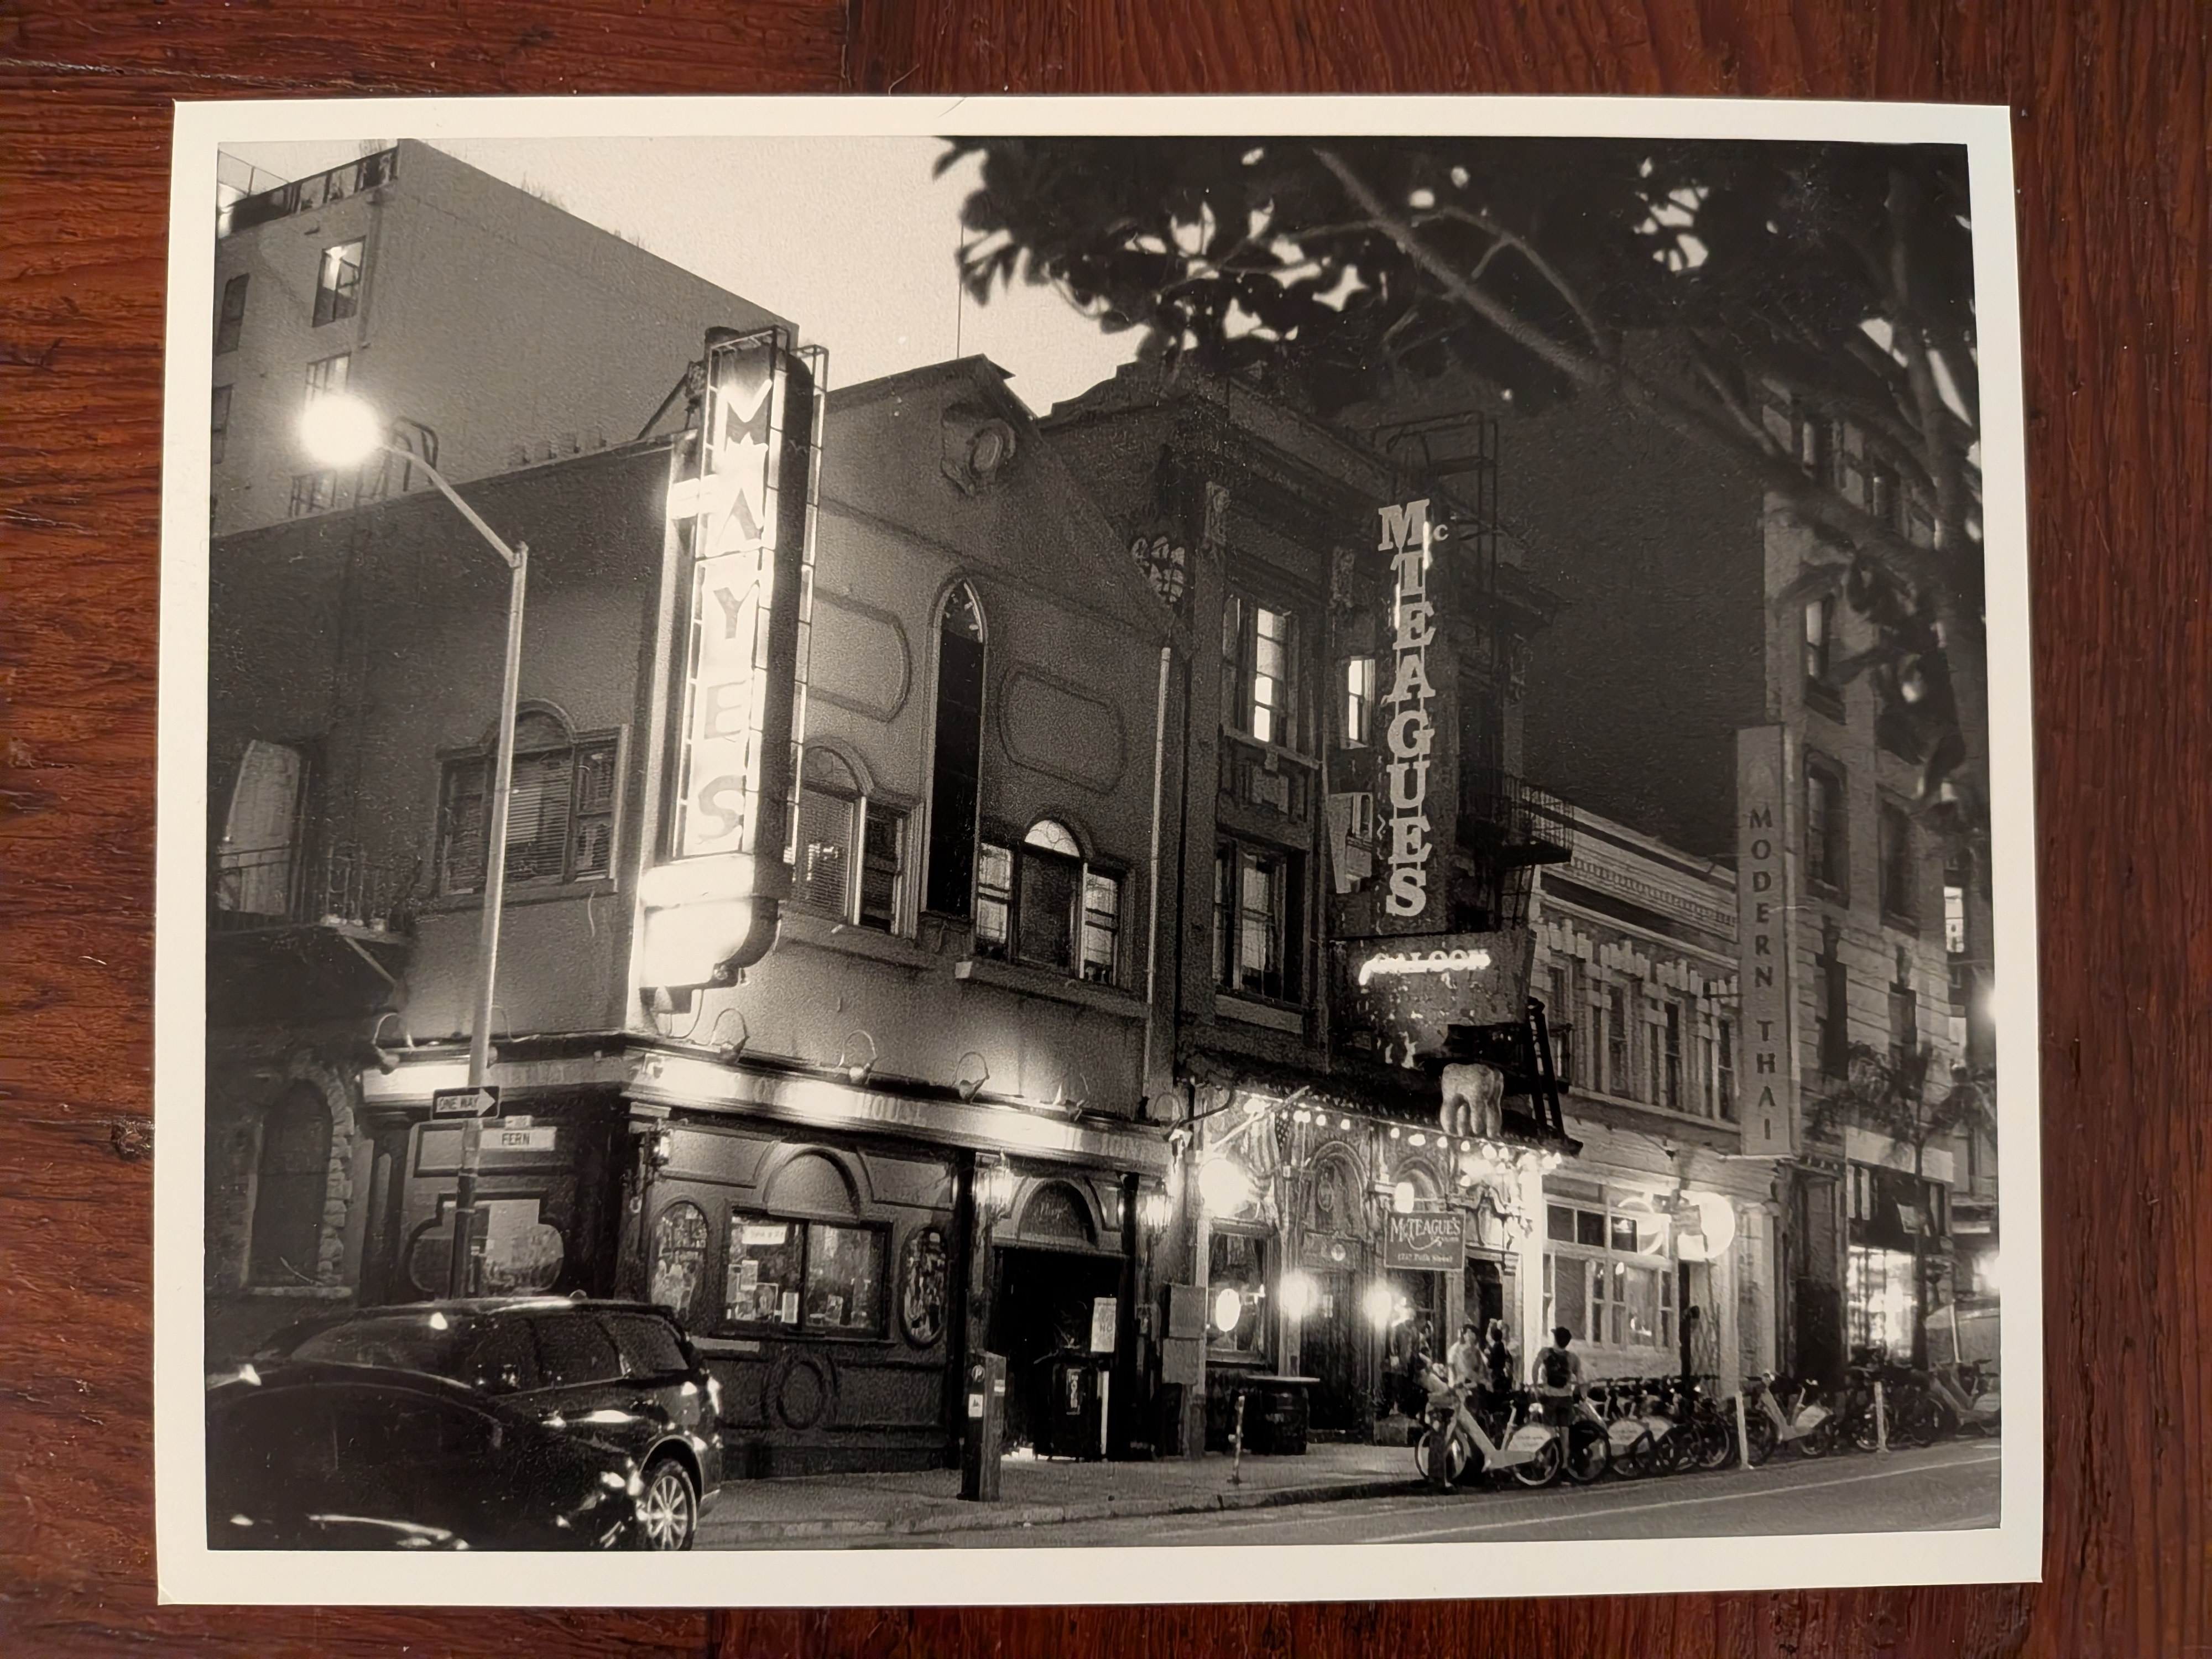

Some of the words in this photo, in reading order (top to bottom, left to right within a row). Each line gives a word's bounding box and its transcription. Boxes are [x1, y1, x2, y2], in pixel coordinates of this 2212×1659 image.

[696, 396, 769, 844] MAYES
[1749, 807, 1773, 988] MODERN
[439, 1097, 457, 1110] ONE
[502, 1133, 530, 1145] FERN
[1756, 1020, 1776, 1140] THAI
